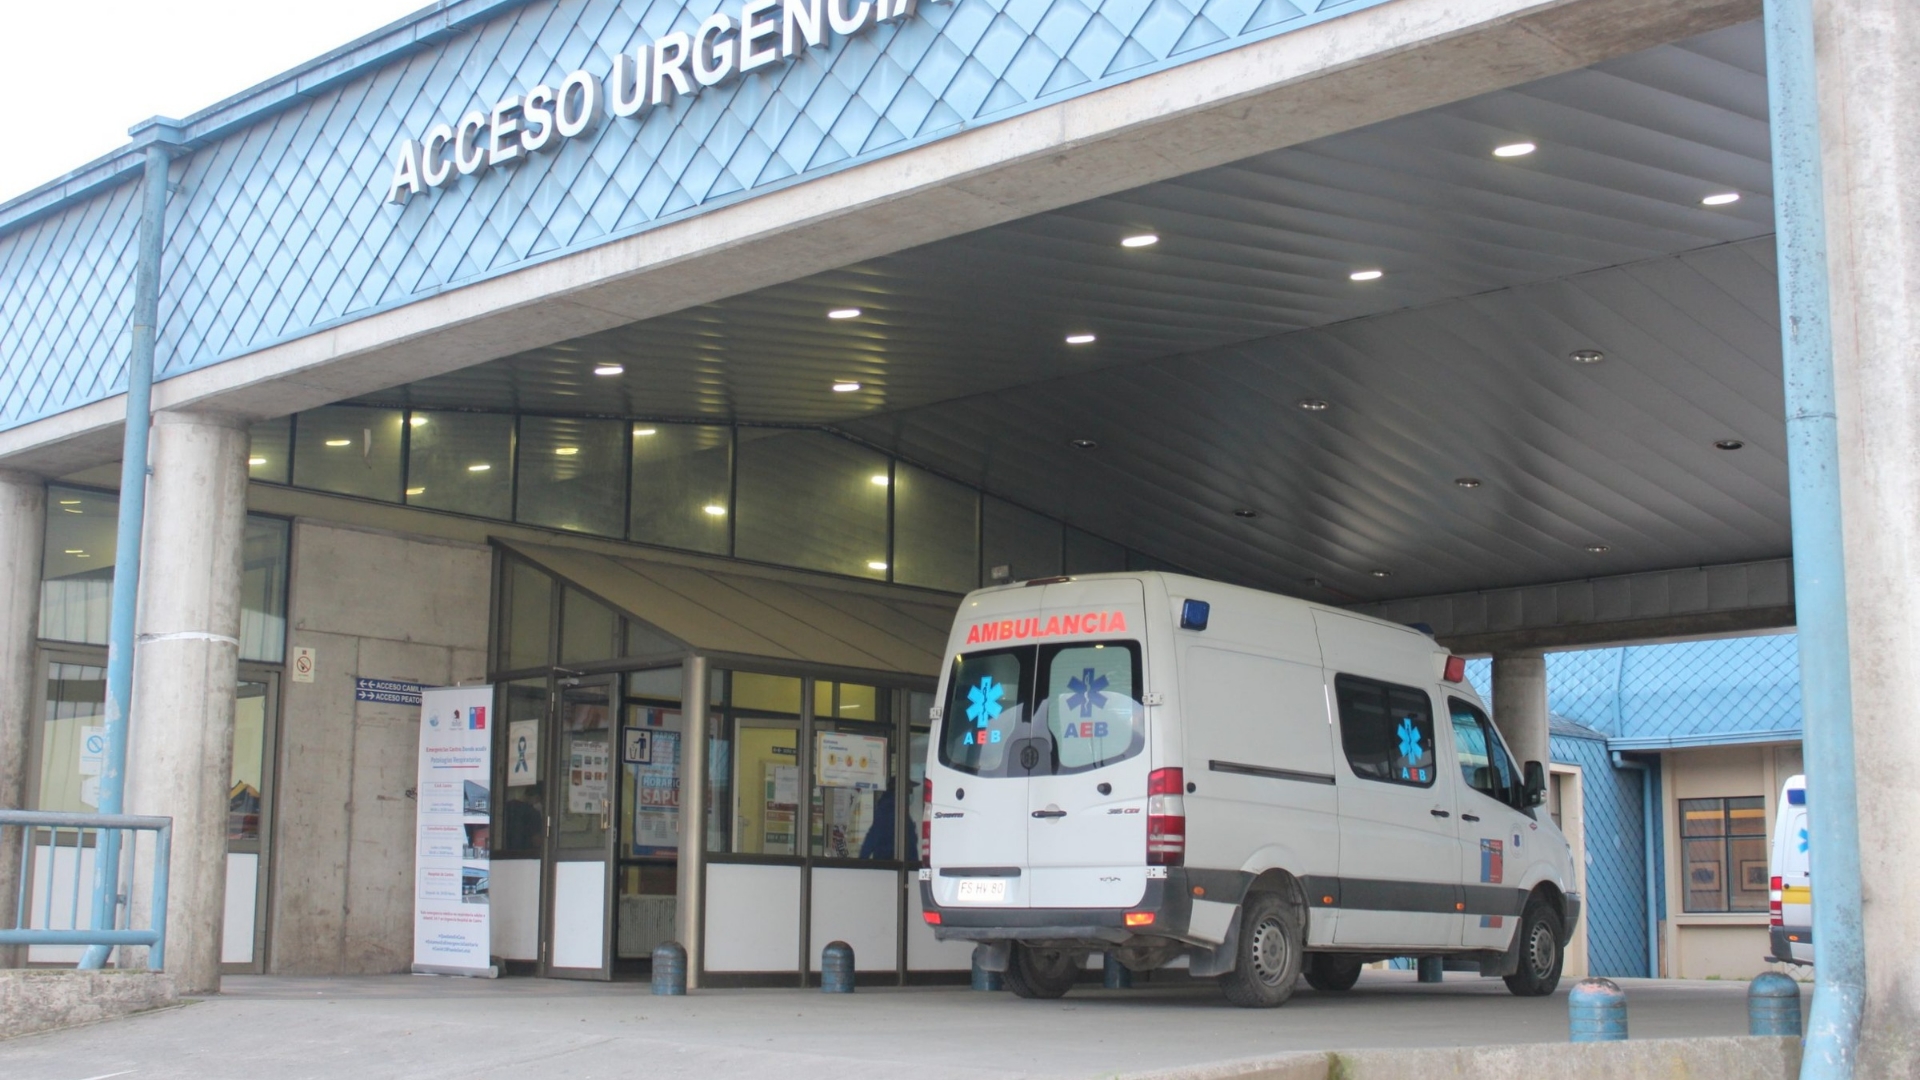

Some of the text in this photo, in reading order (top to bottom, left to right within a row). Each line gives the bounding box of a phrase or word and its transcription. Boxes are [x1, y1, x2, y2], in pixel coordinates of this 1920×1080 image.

[388, 69, 598, 205] ACCESO
[966, 611, 1127, 645] AMBULANCIA
[376, 681, 401, 691] ACCESO
[375, 693, 400, 702] ACCESO
[963, 730, 1001, 745] AEB
[1064, 721, 1109, 739] AEB
[1402, 766, 1426, 782] AEB
